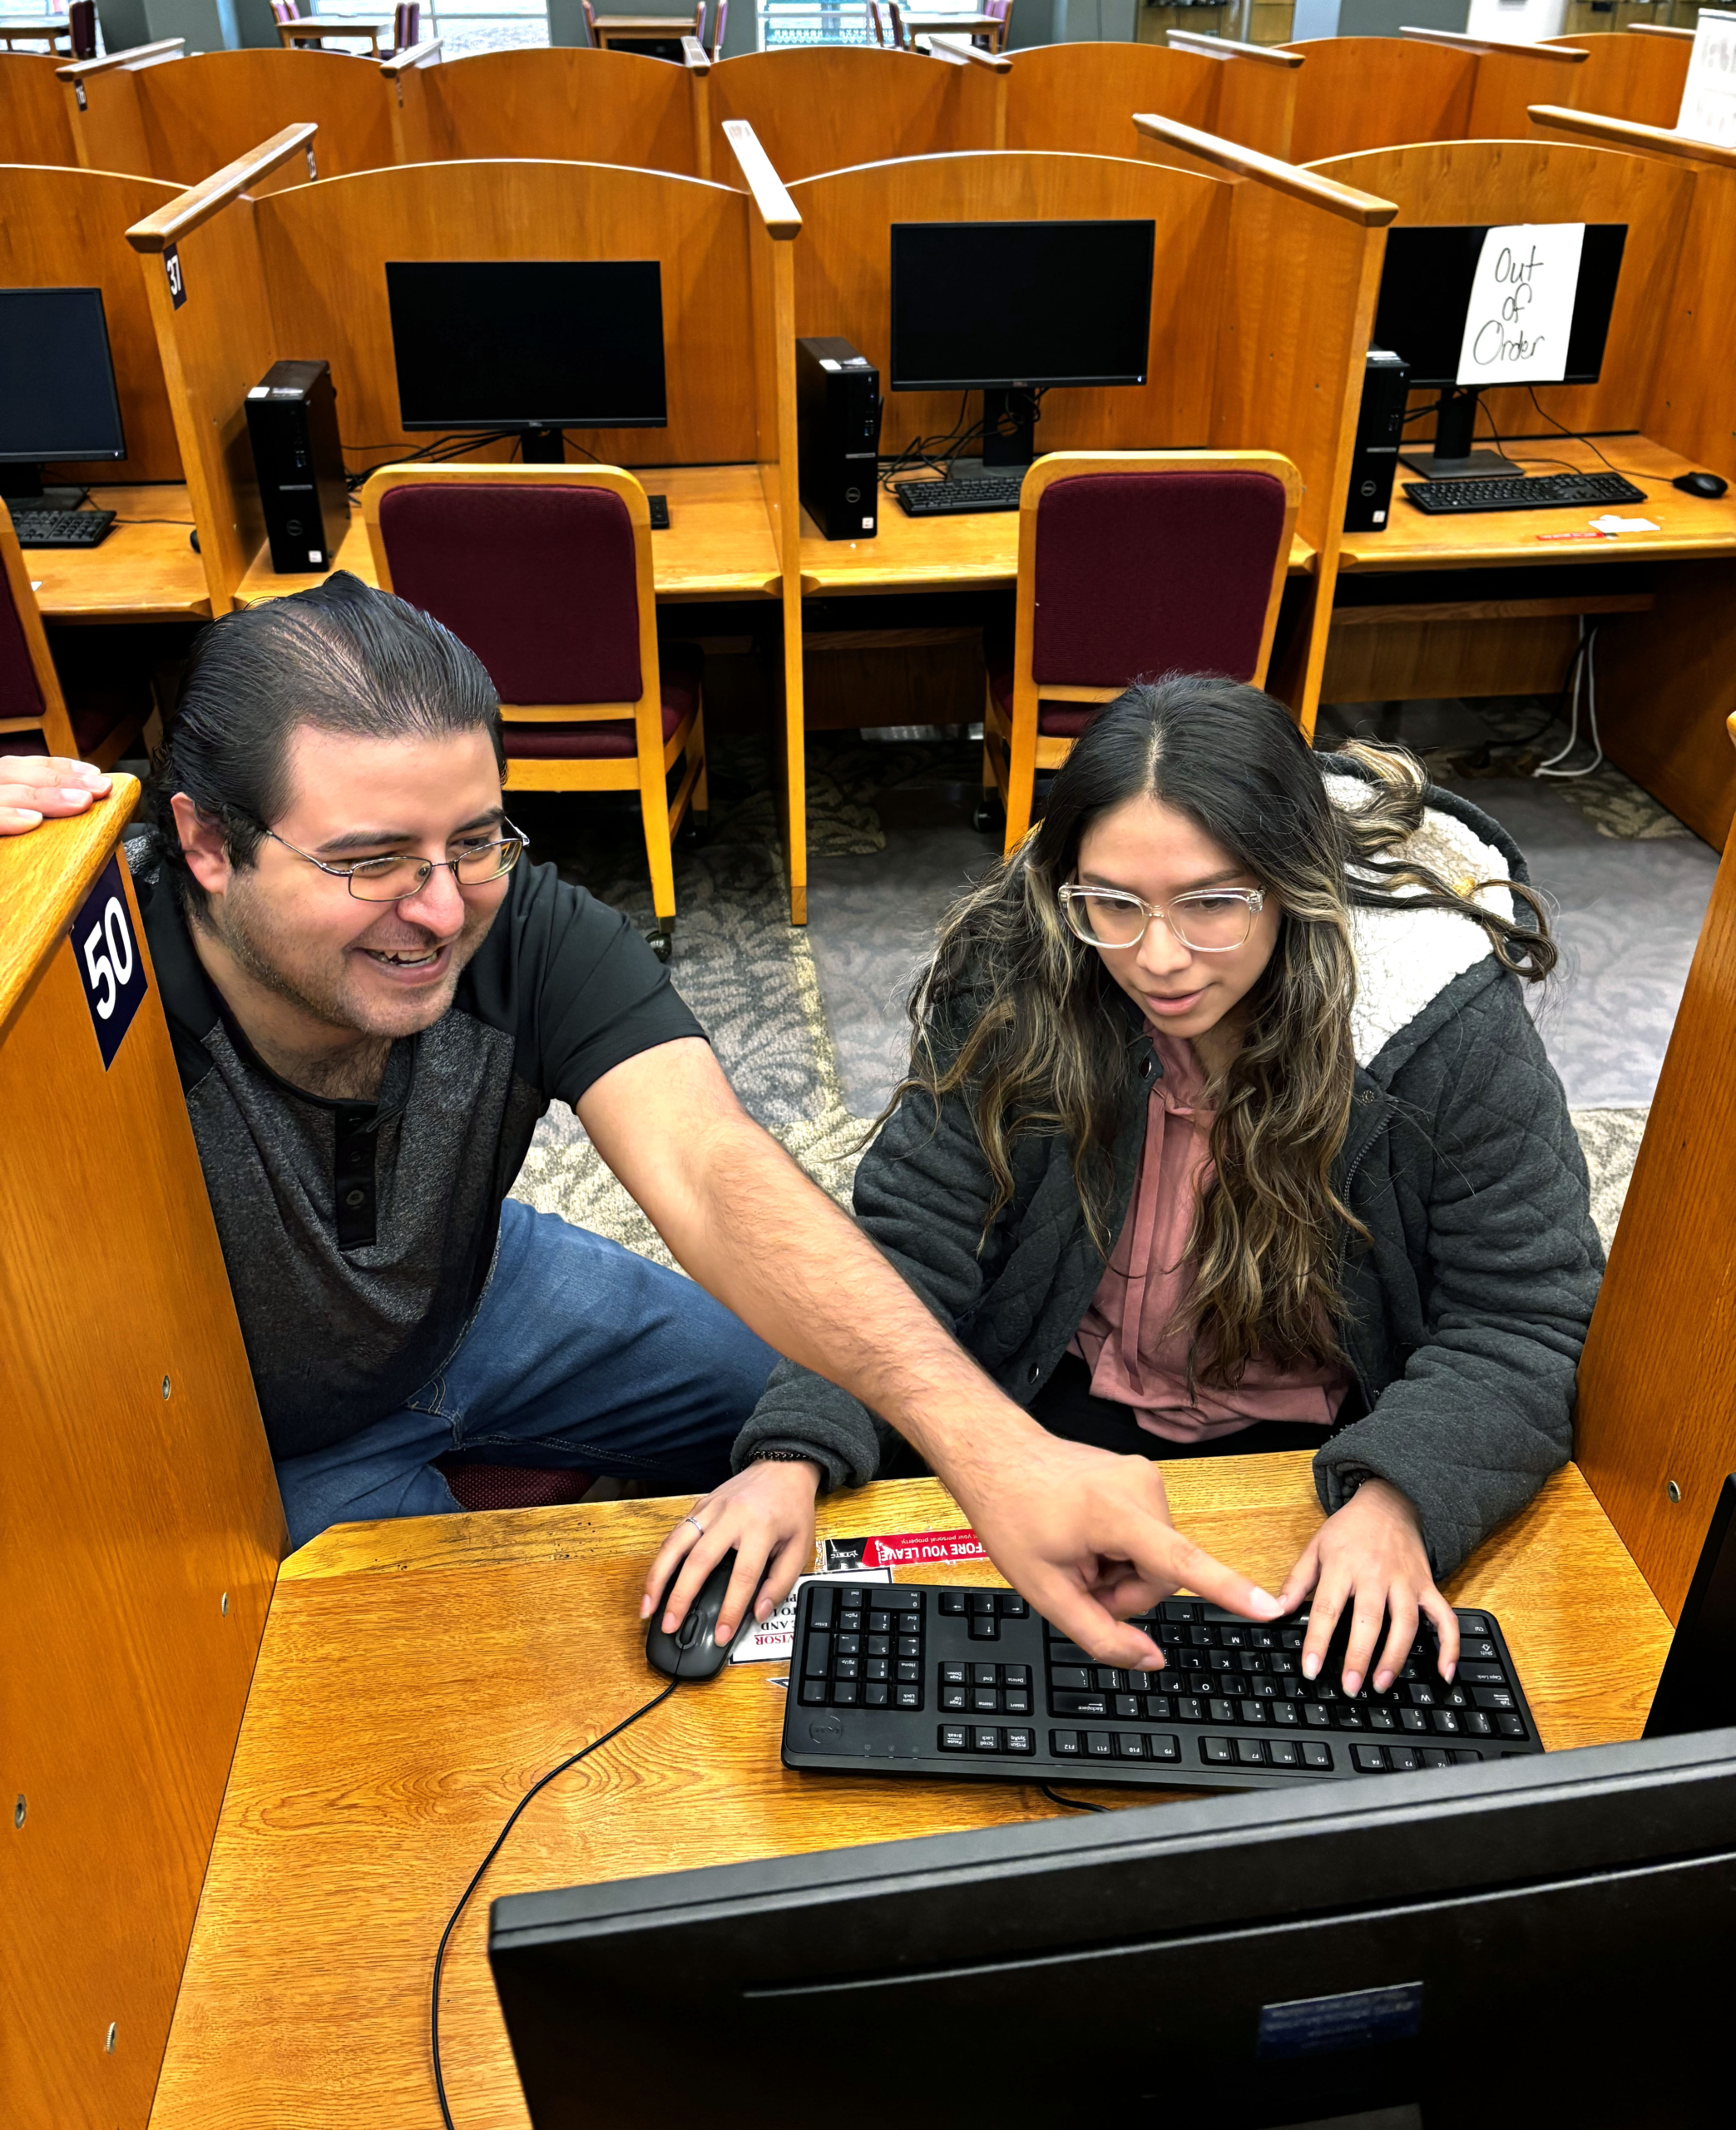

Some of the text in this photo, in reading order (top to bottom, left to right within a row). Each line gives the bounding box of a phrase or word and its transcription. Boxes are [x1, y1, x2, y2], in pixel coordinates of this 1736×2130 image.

[167, 255, 181, 295] 37
[1495, 245, 1544, 284] Out
[1502, 282, 1532, 324] of
[1473, 320, 1546, 365] Order
[83, 896, 133, 1019] 50
[922, 1545, 947, 1556] YOU
[930, 1535, 957, 1543] personal
[950, 1542, 987, 1555] FORE
[760, 1621, 789, 1631] AND
[1454, 1695, 1462, 1703] Q
